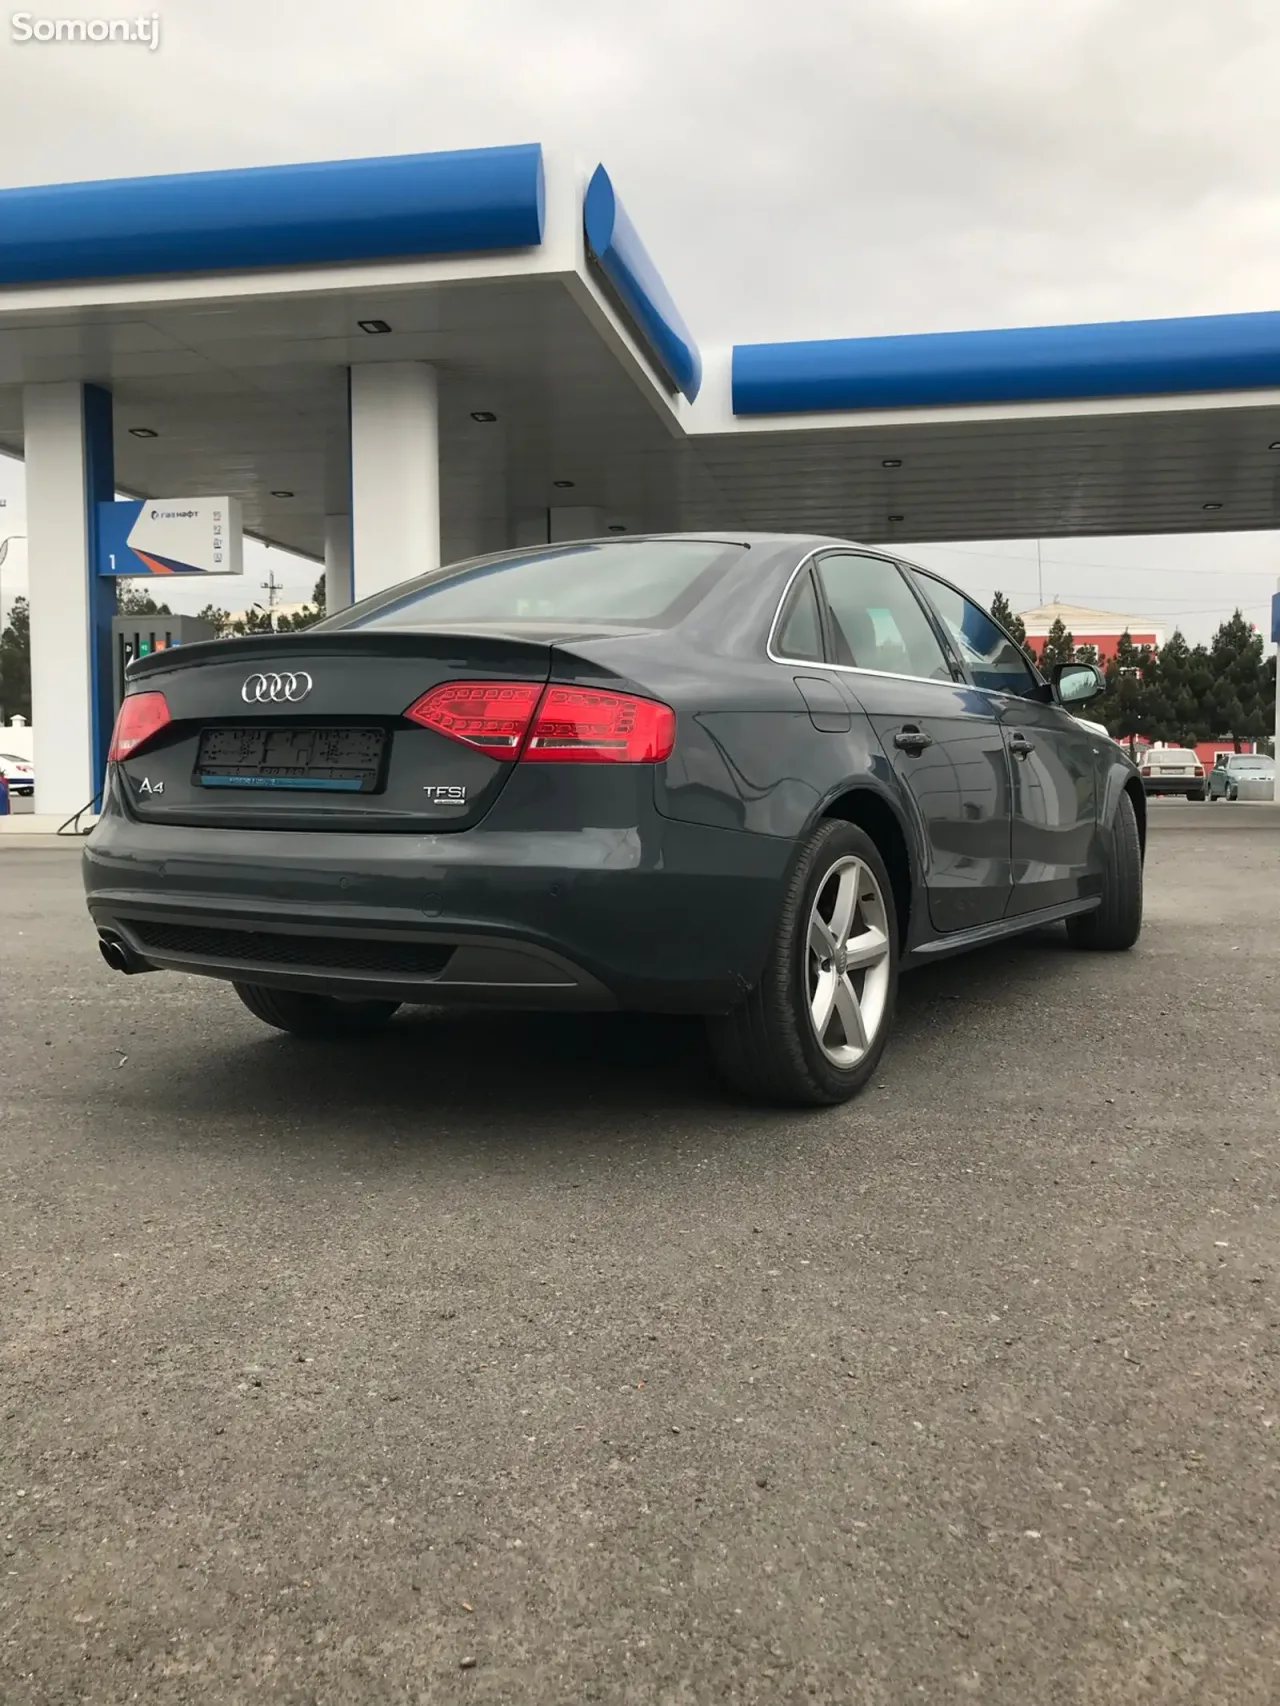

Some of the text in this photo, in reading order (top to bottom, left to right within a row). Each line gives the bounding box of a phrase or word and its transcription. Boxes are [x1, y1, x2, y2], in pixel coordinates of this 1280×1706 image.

[109, 554, 116, 570] 1
[138, 777, 164, 794] A4
[423, 786, 466, 798] TFSI
